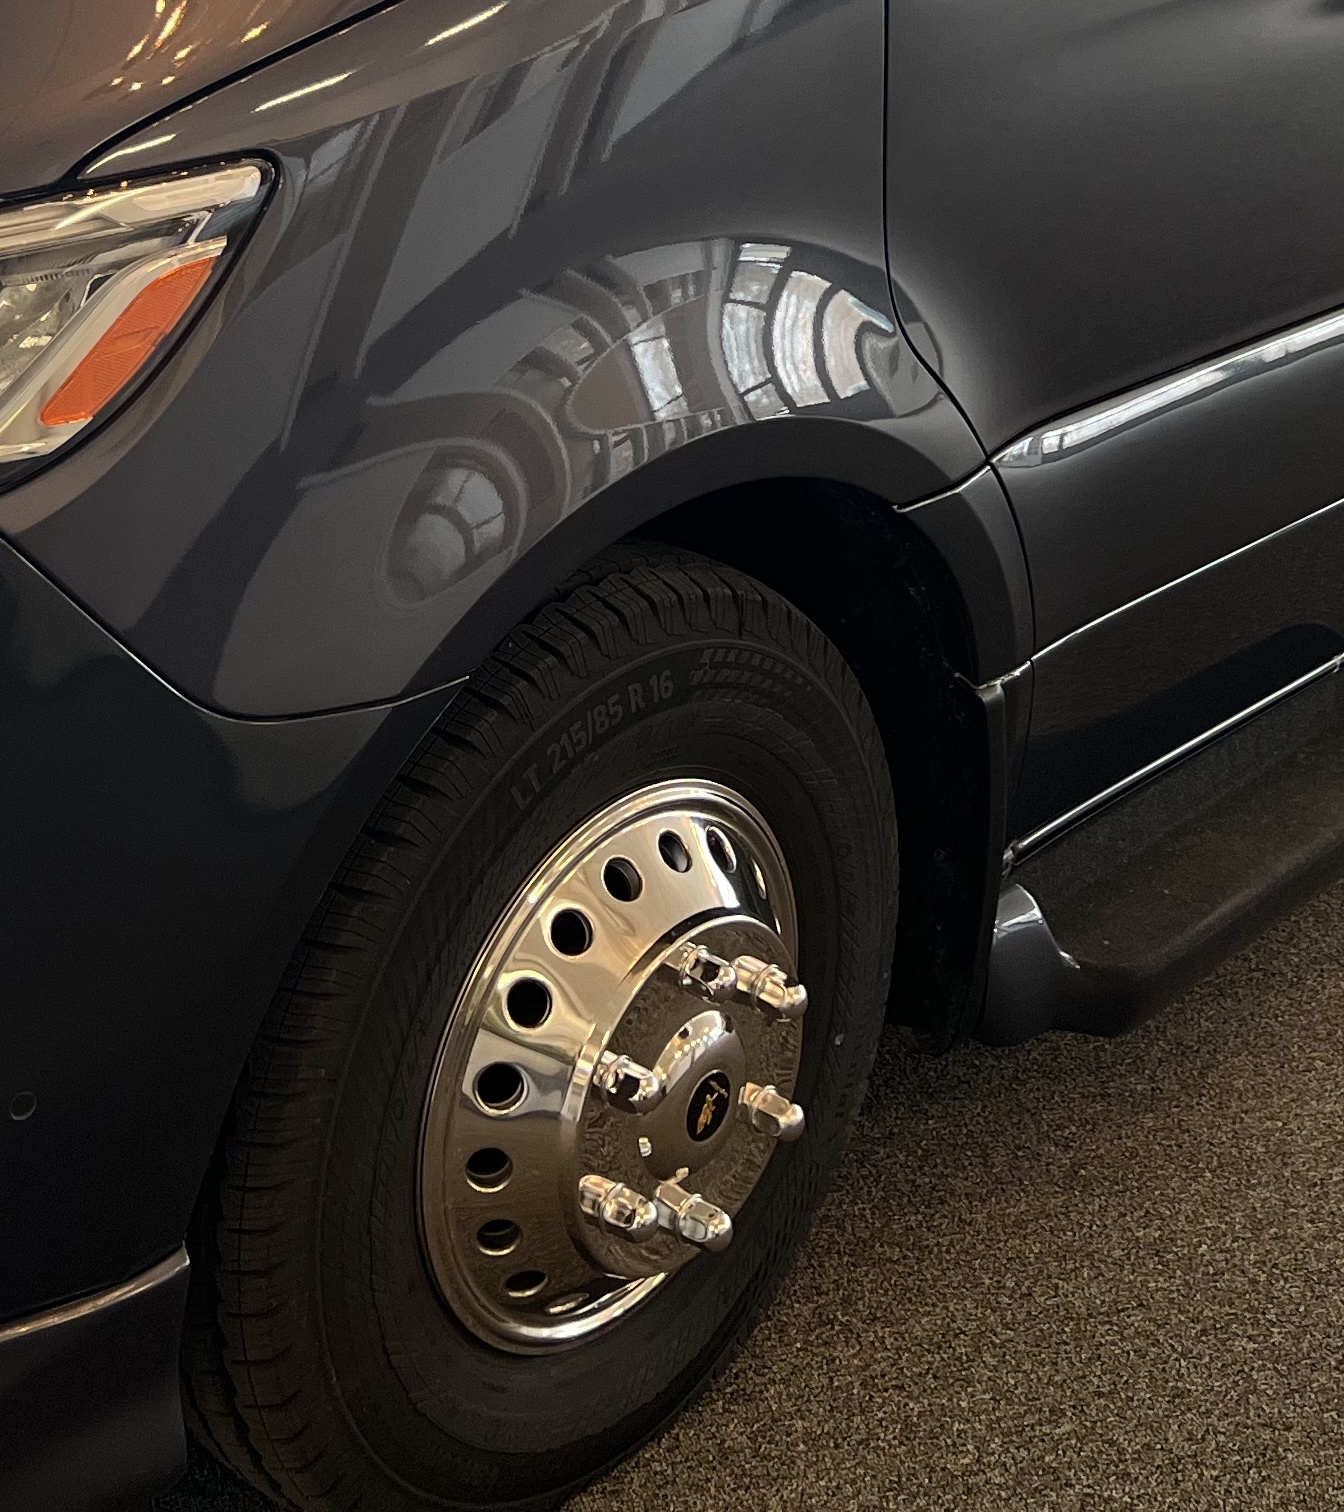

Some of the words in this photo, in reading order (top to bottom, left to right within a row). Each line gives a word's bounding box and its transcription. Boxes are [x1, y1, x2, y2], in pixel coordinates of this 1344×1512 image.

[509, 762, 543, 813] LT
[546, 694, 624, 775] 215/85
[627, 682, 647, 714] R
[649, 669, 675, 704] 16
